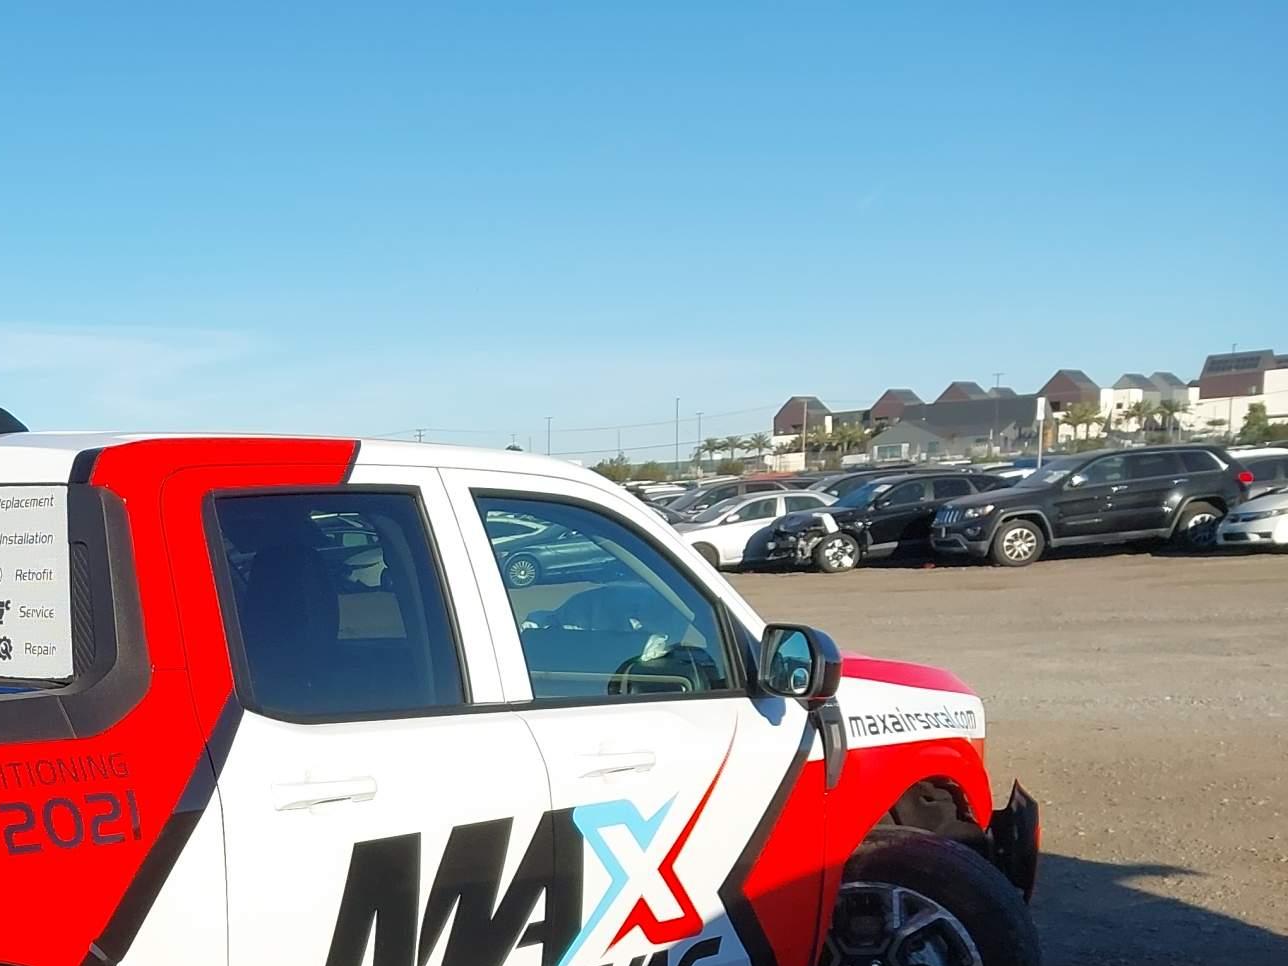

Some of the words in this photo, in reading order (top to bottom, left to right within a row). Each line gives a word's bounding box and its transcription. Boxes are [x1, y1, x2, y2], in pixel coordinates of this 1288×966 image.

[0, 531, 54, 545] Installation
[15, 569, 53, 581] Retrofit
[19, 606, 54, 619] Service
[24, 642, 57, 657] Repair
[848, 705, 977, 738] maxairsocal.com
